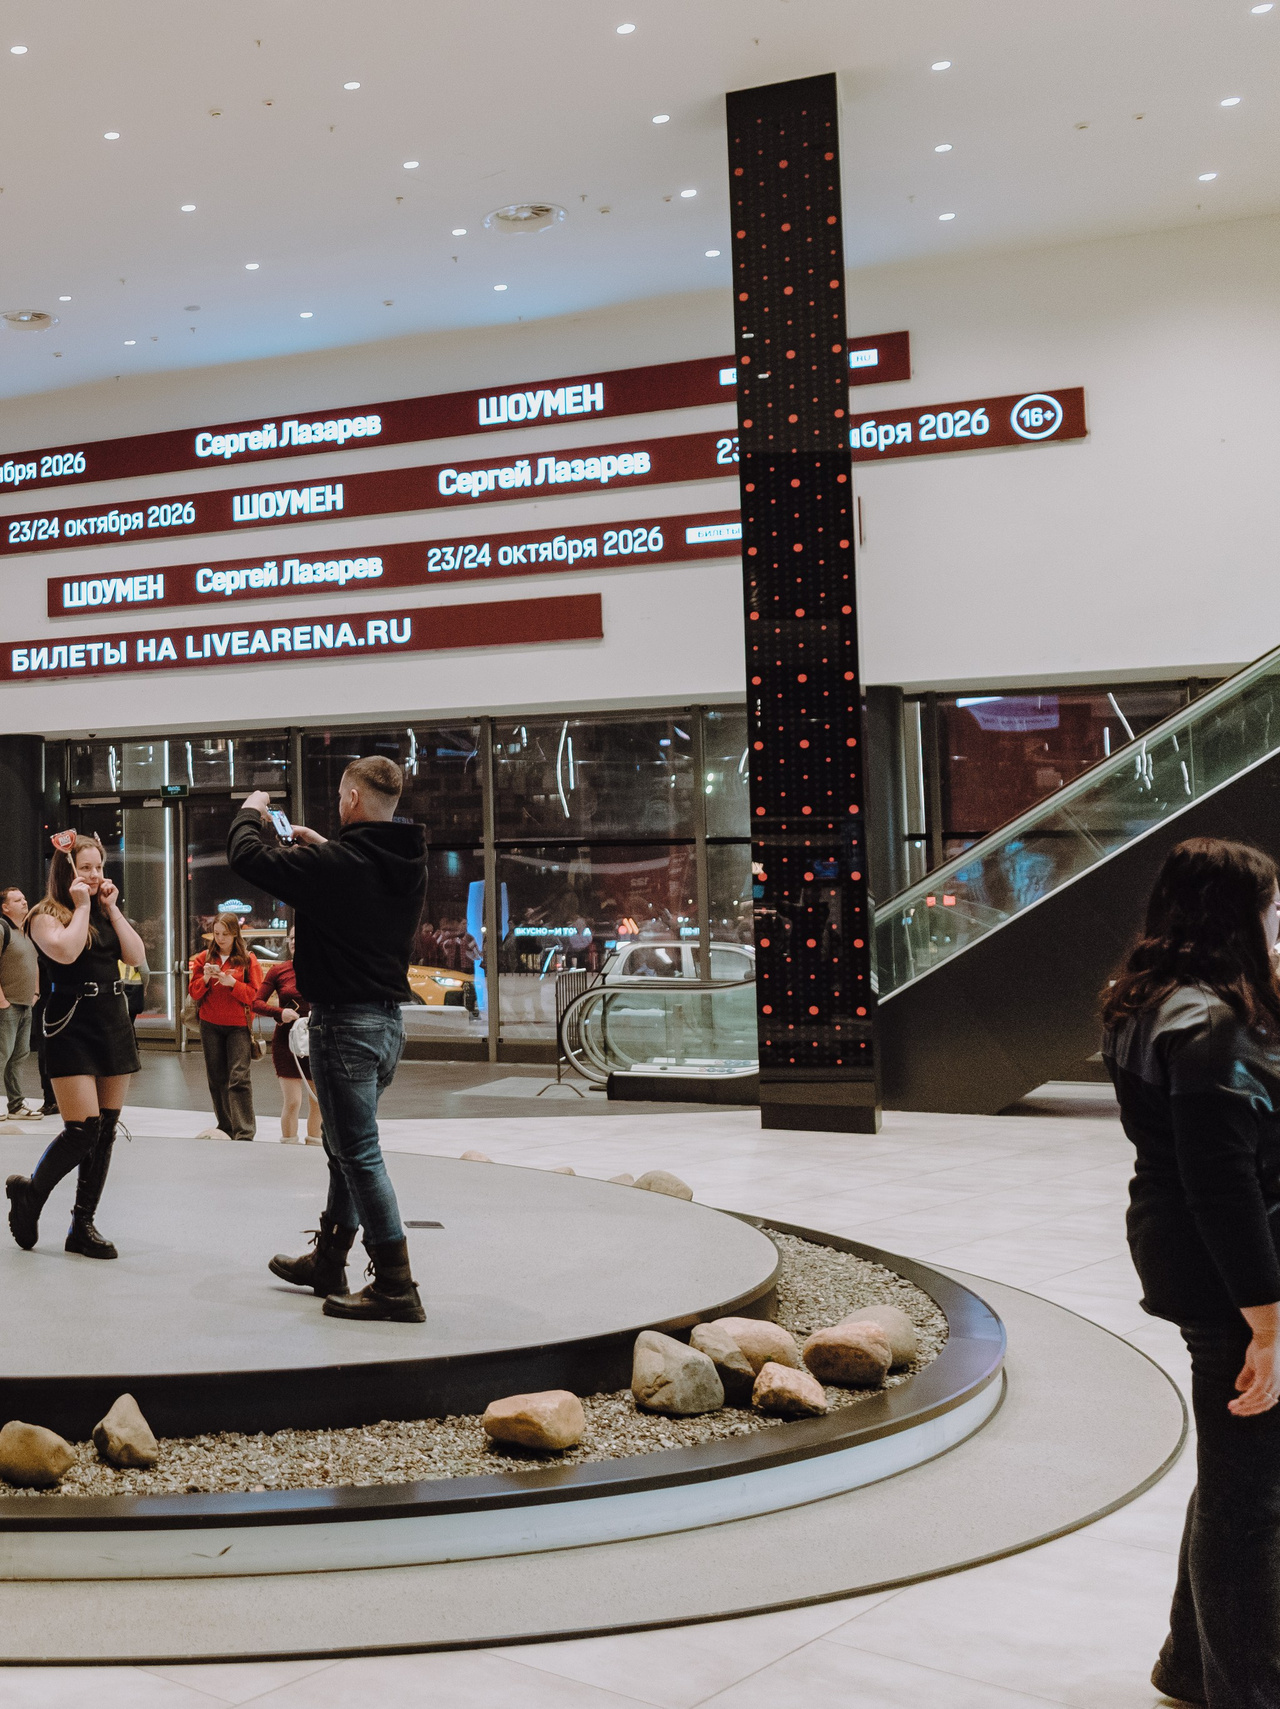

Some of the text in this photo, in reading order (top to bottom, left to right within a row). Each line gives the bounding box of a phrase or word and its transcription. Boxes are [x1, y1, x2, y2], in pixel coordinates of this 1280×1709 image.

[41, 451, 85, 477] 2026
[195, 423, 278, 460] Сергей
[279, 414, 382, 448] Лазарев
[478, 382, 604, 426] ШОУМЕН
[919, 407, 990, 442] 2026
[1019, 407, 1055, 428] 16+
[9, 517, 60, 544] 23/24
[64, 509, 144, 538] октября
[148, 501, 196, 529] 2026
[233, 483, 344, 522] ШОУМЕН
[439, 459, 532, 498] Сергей
[533, 452, 652, 486] Лазарев
[63, 525, 741, 608] ШОУМЕН Сергей Лазарев 23/24 октября 2026 БИЛЕТЫ
[11, 618, 412, 671] БИЛЕТЫ НА LIVEARENA.RU
[514, 927, 548, 937] ВКУСНО
